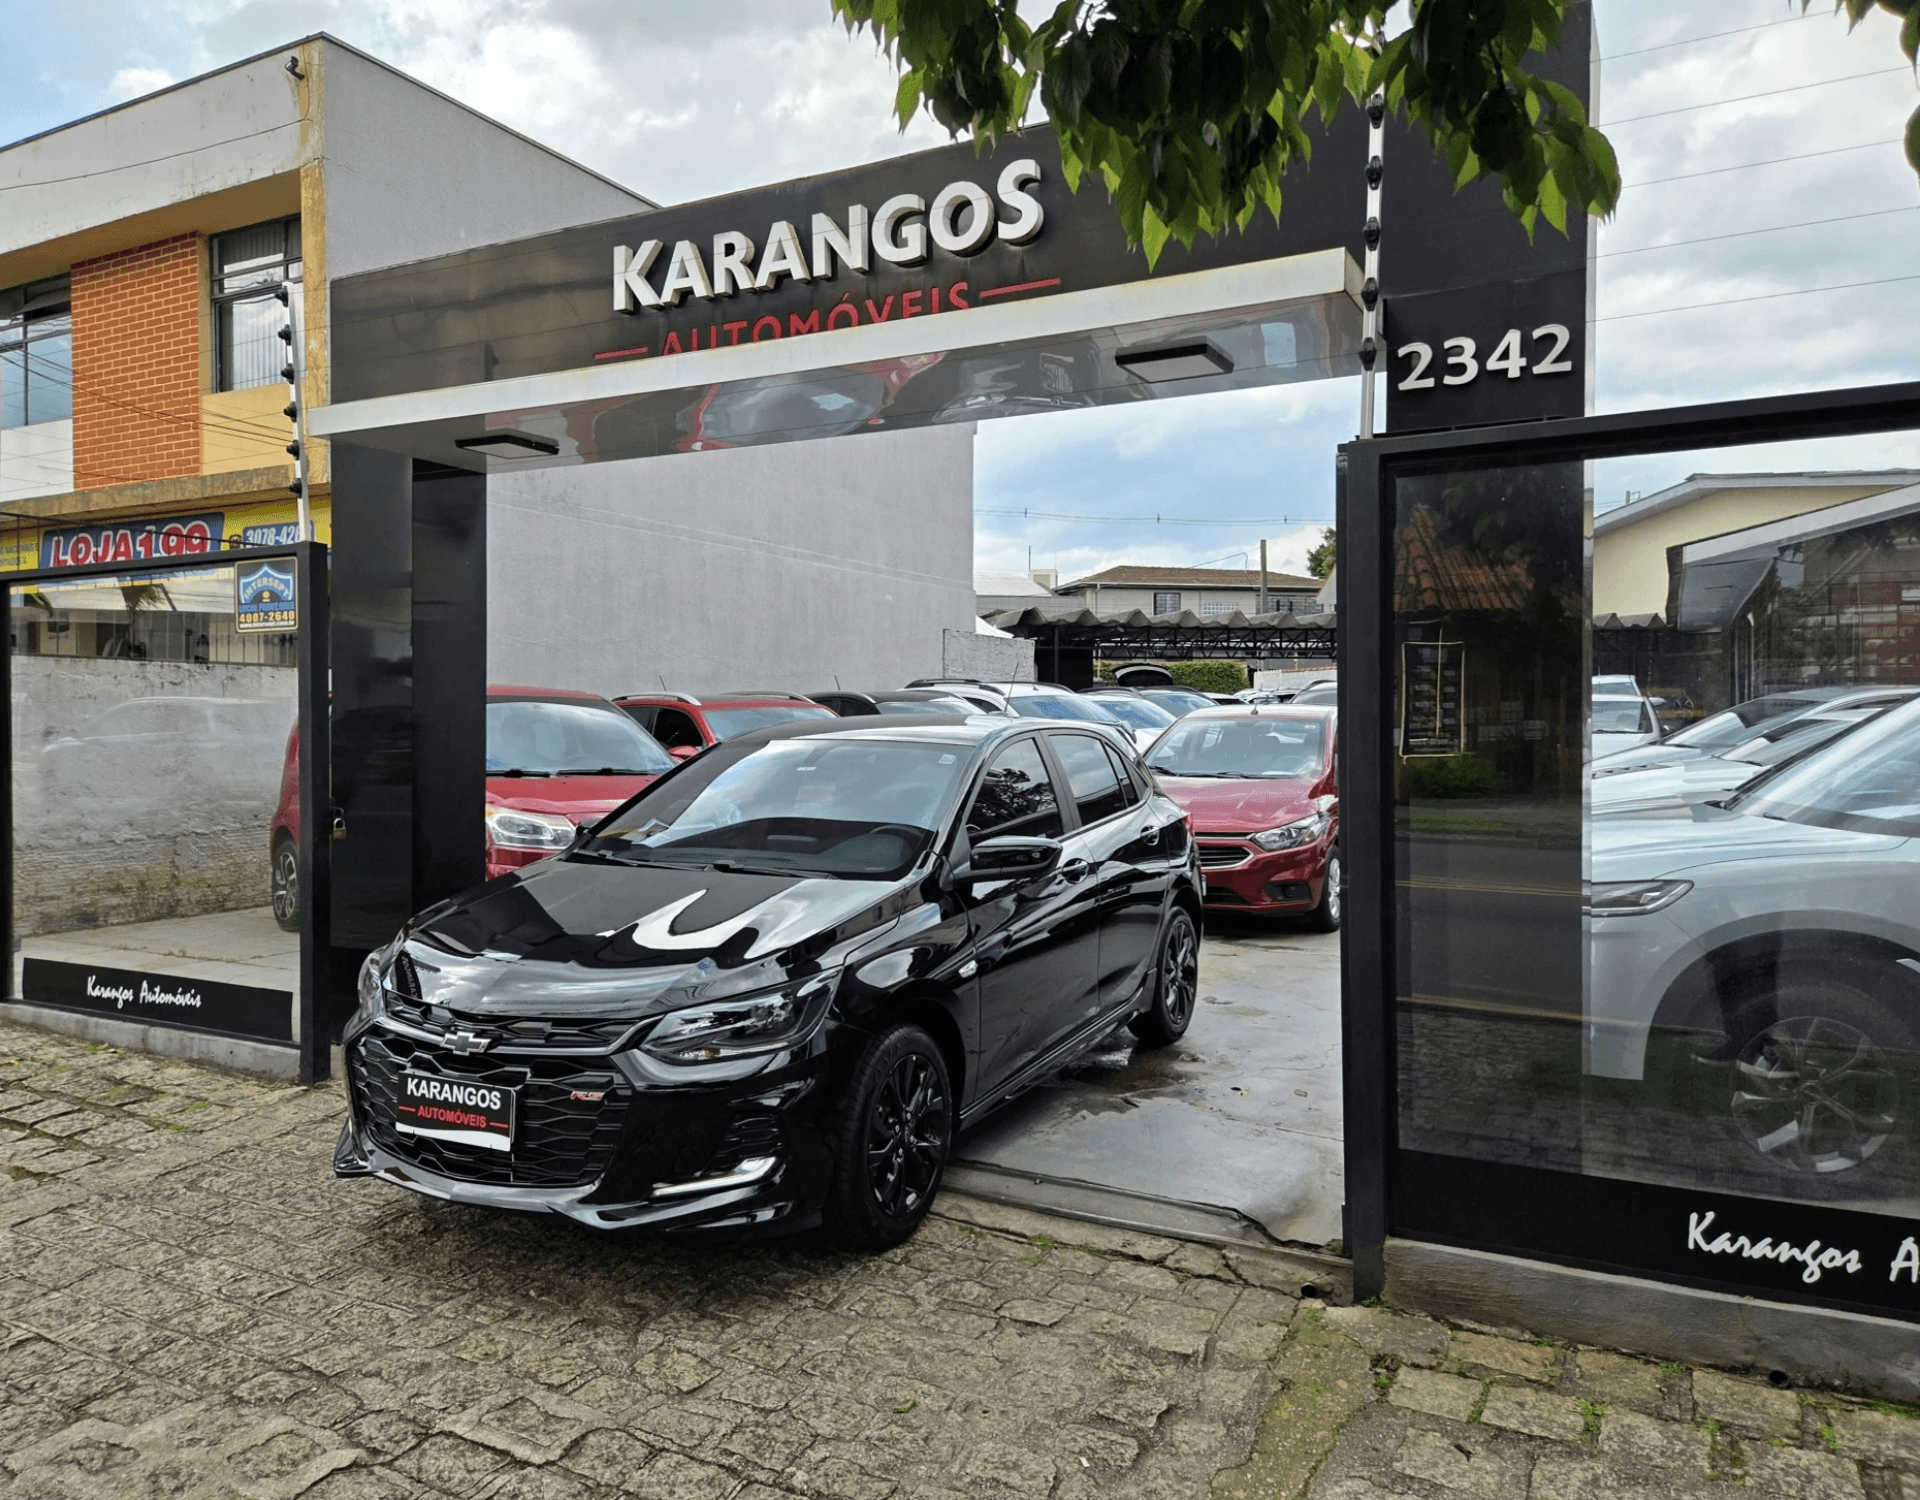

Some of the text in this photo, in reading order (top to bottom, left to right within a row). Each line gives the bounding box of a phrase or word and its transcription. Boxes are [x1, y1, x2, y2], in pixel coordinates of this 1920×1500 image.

[613, 159, 1045, 313] KARANGOS
[662, 281, 970, 356] AUTOMÓVEIS
[1397, 323, 1573, 391] 2342
[243, 577, 291, 600] INTERSEPT
[239, 610, 297, 622] 4007-2640
[87, 975, 202, 1009] Karangos Automóveis
[406, 1077, 501, 1110] KARANGOS
[417, 1104, 488, 1129] AUTOMÓVEIS
[1687, 1210, 1920, 1284] Karangos A
